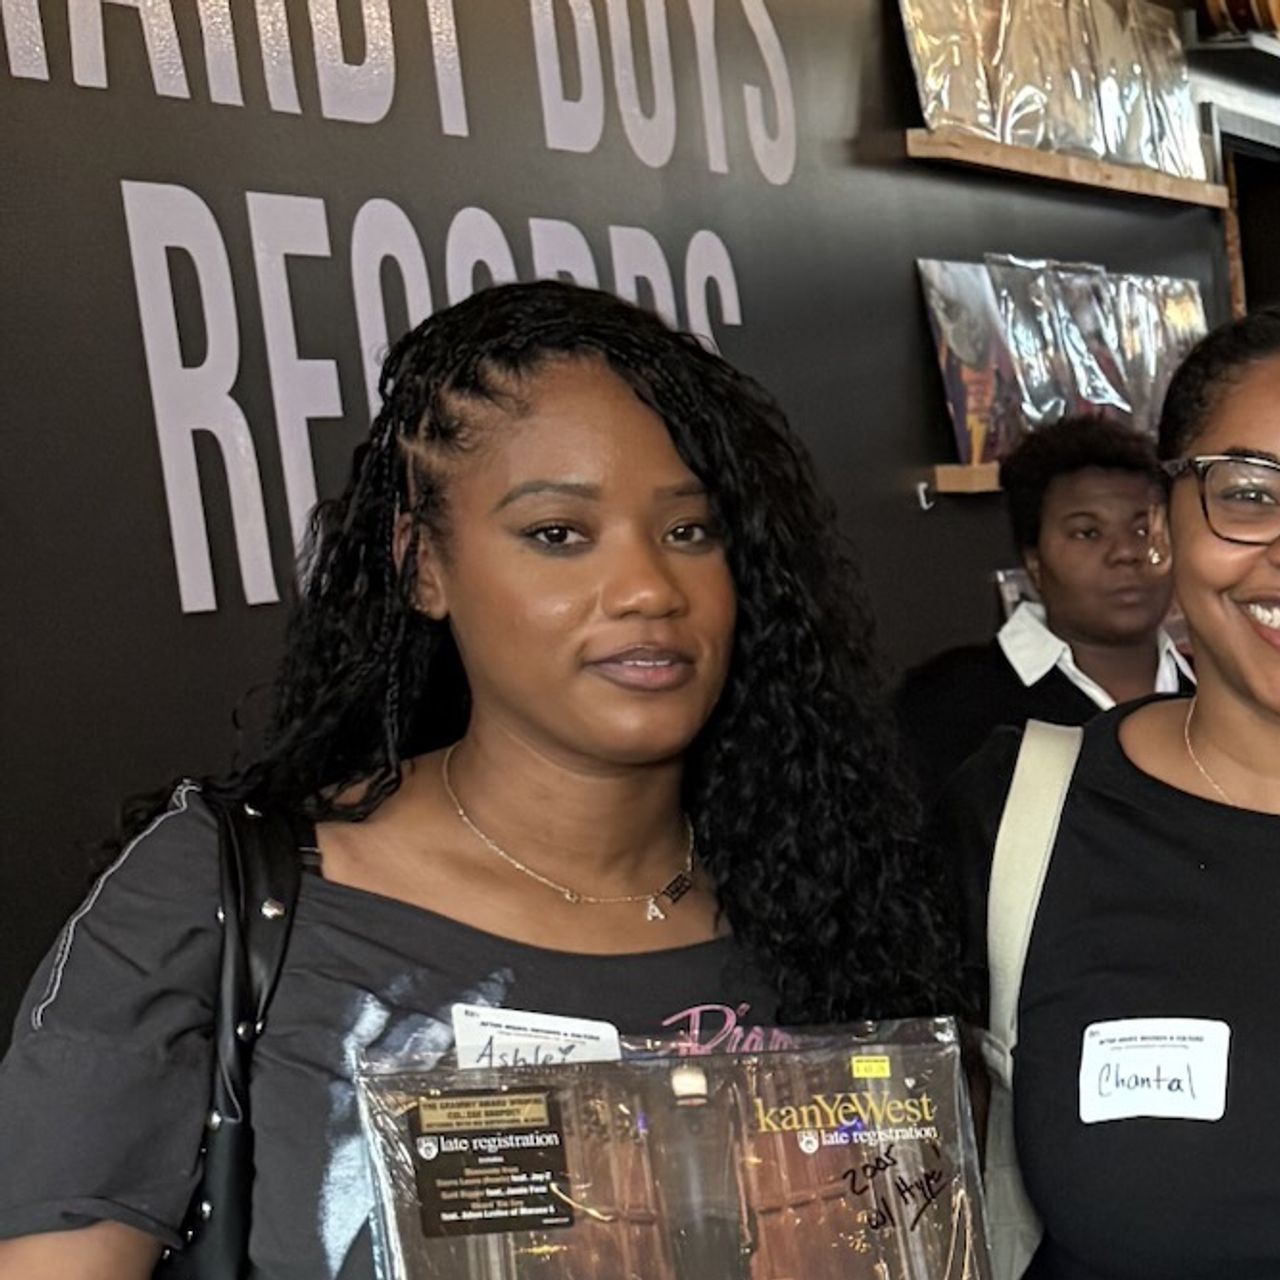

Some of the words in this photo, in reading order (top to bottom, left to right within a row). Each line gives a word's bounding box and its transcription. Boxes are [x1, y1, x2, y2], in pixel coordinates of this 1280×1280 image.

[1098, 1062, 1197, 1101] Chantal
[440, 1135, 470, 1152] late
[472, 1131, 561, 1154] registration
[822, 1129, 850, 1146] late
[852, 1123, 938, 1146] registration
[843, 1144, 898, 1196] 2005
